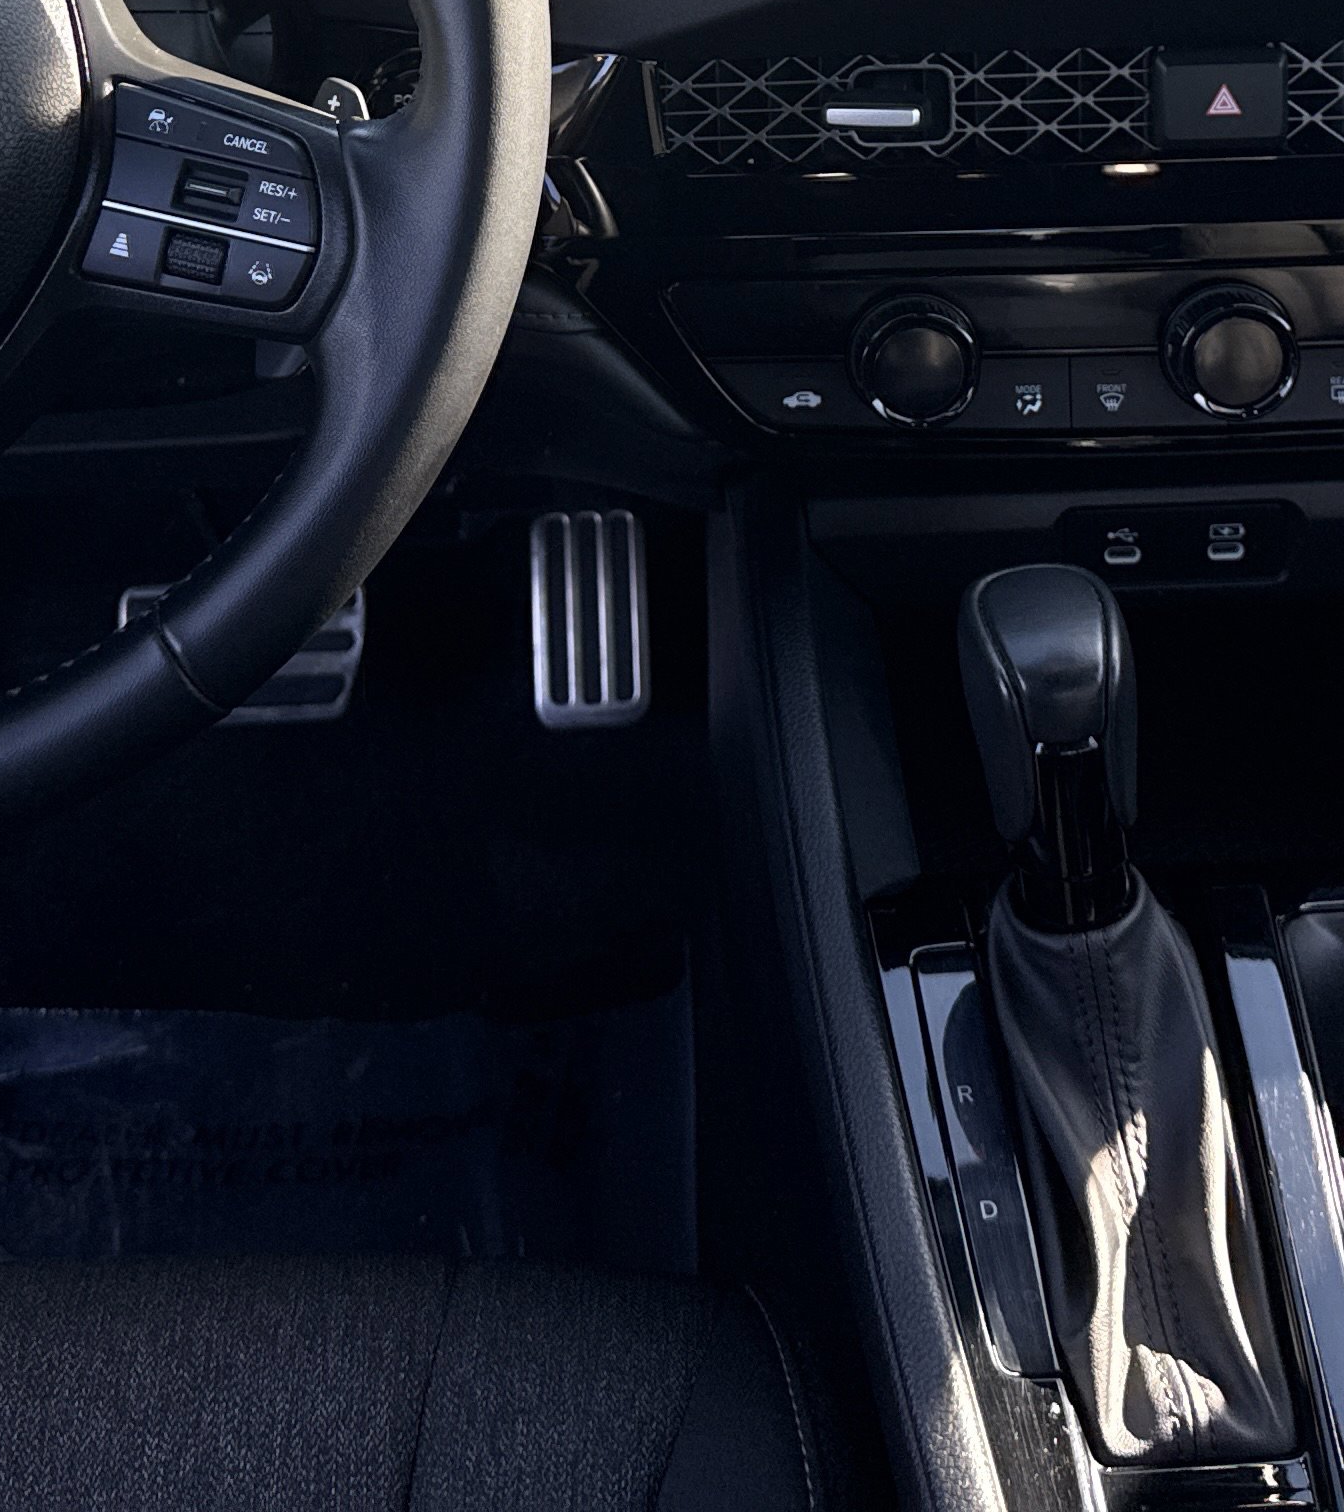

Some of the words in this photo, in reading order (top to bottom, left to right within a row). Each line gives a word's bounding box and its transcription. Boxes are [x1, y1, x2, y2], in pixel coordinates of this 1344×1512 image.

[223, 133, 269, 155] CANCEL
[258, 180, 299, 200] RES/+
[252, 207, 291, 225] SET/-
[1015, 384, 1043, 394] MODE
[1096, 383, 1128, 393] FRONT
[956, 1085, 975, 1104] R
[979, 1199, 999, 1220] D
